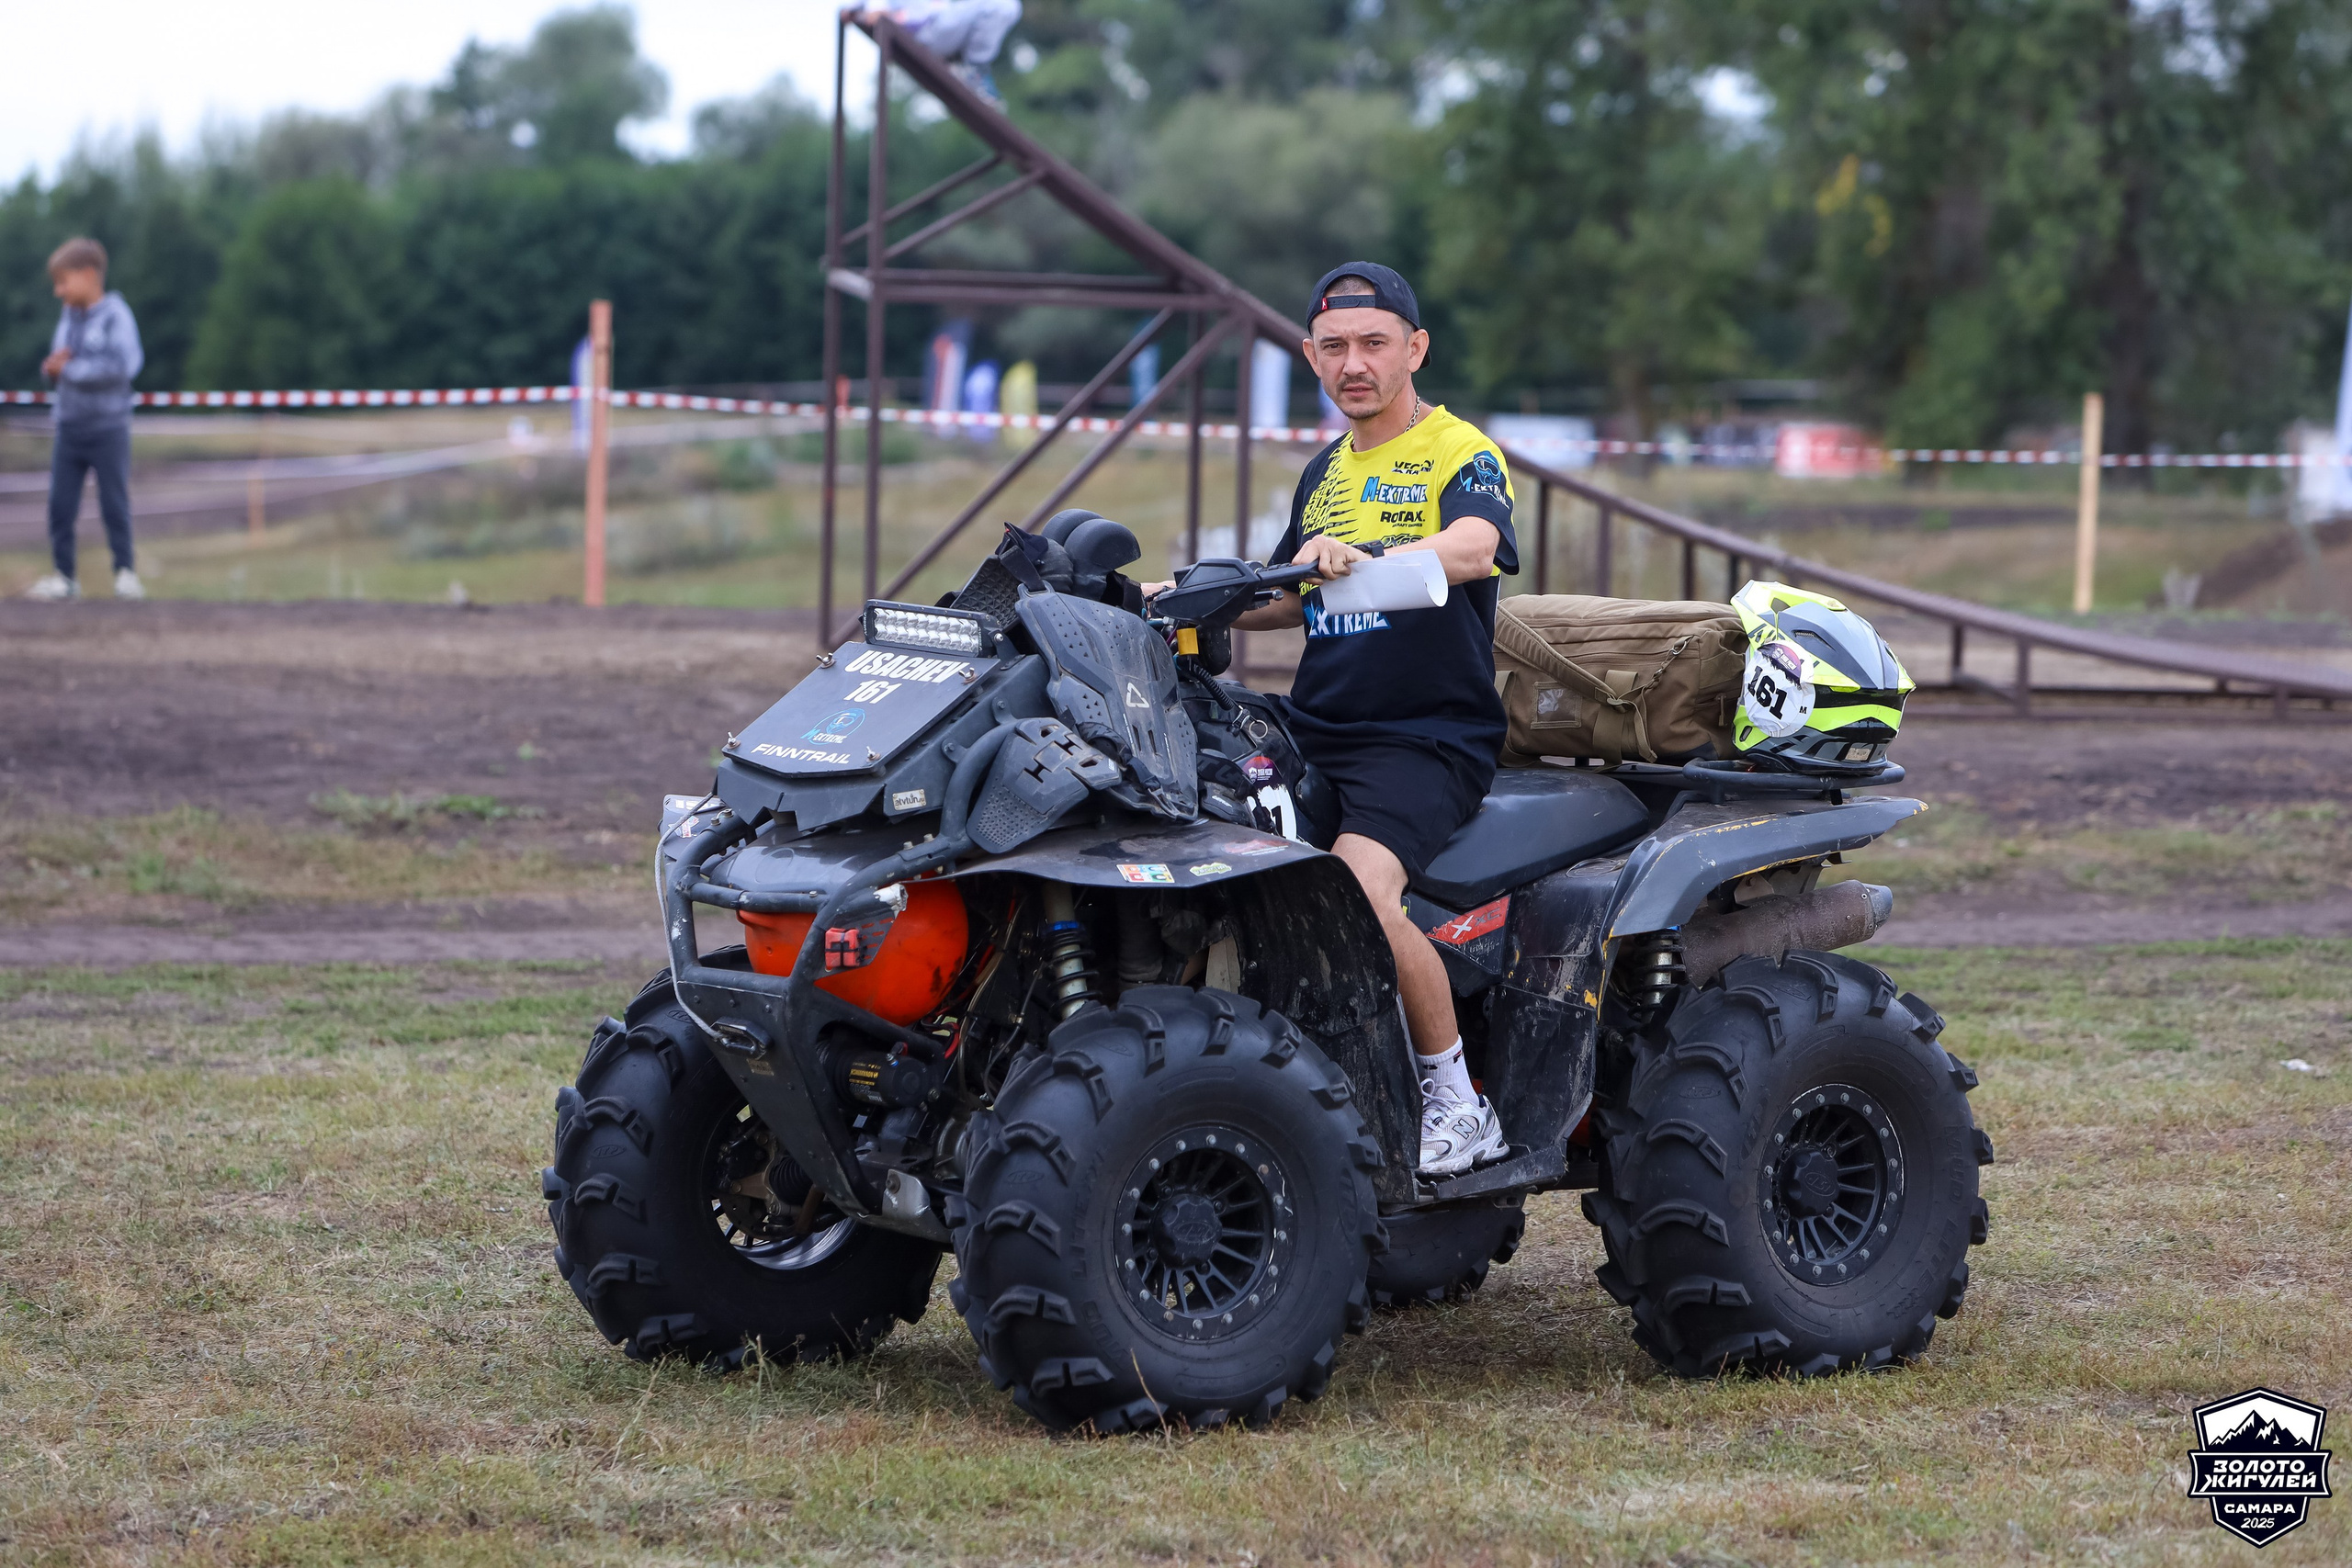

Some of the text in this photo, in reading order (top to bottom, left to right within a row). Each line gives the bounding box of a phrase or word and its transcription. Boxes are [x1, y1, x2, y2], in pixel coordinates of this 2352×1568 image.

[844, 650, 970, 683] USACHEV
[843, 680, 902, 705] 161
[1747, 665, 1787, 720] 161
[751, 743, 851, 764] FINNTRAIL
